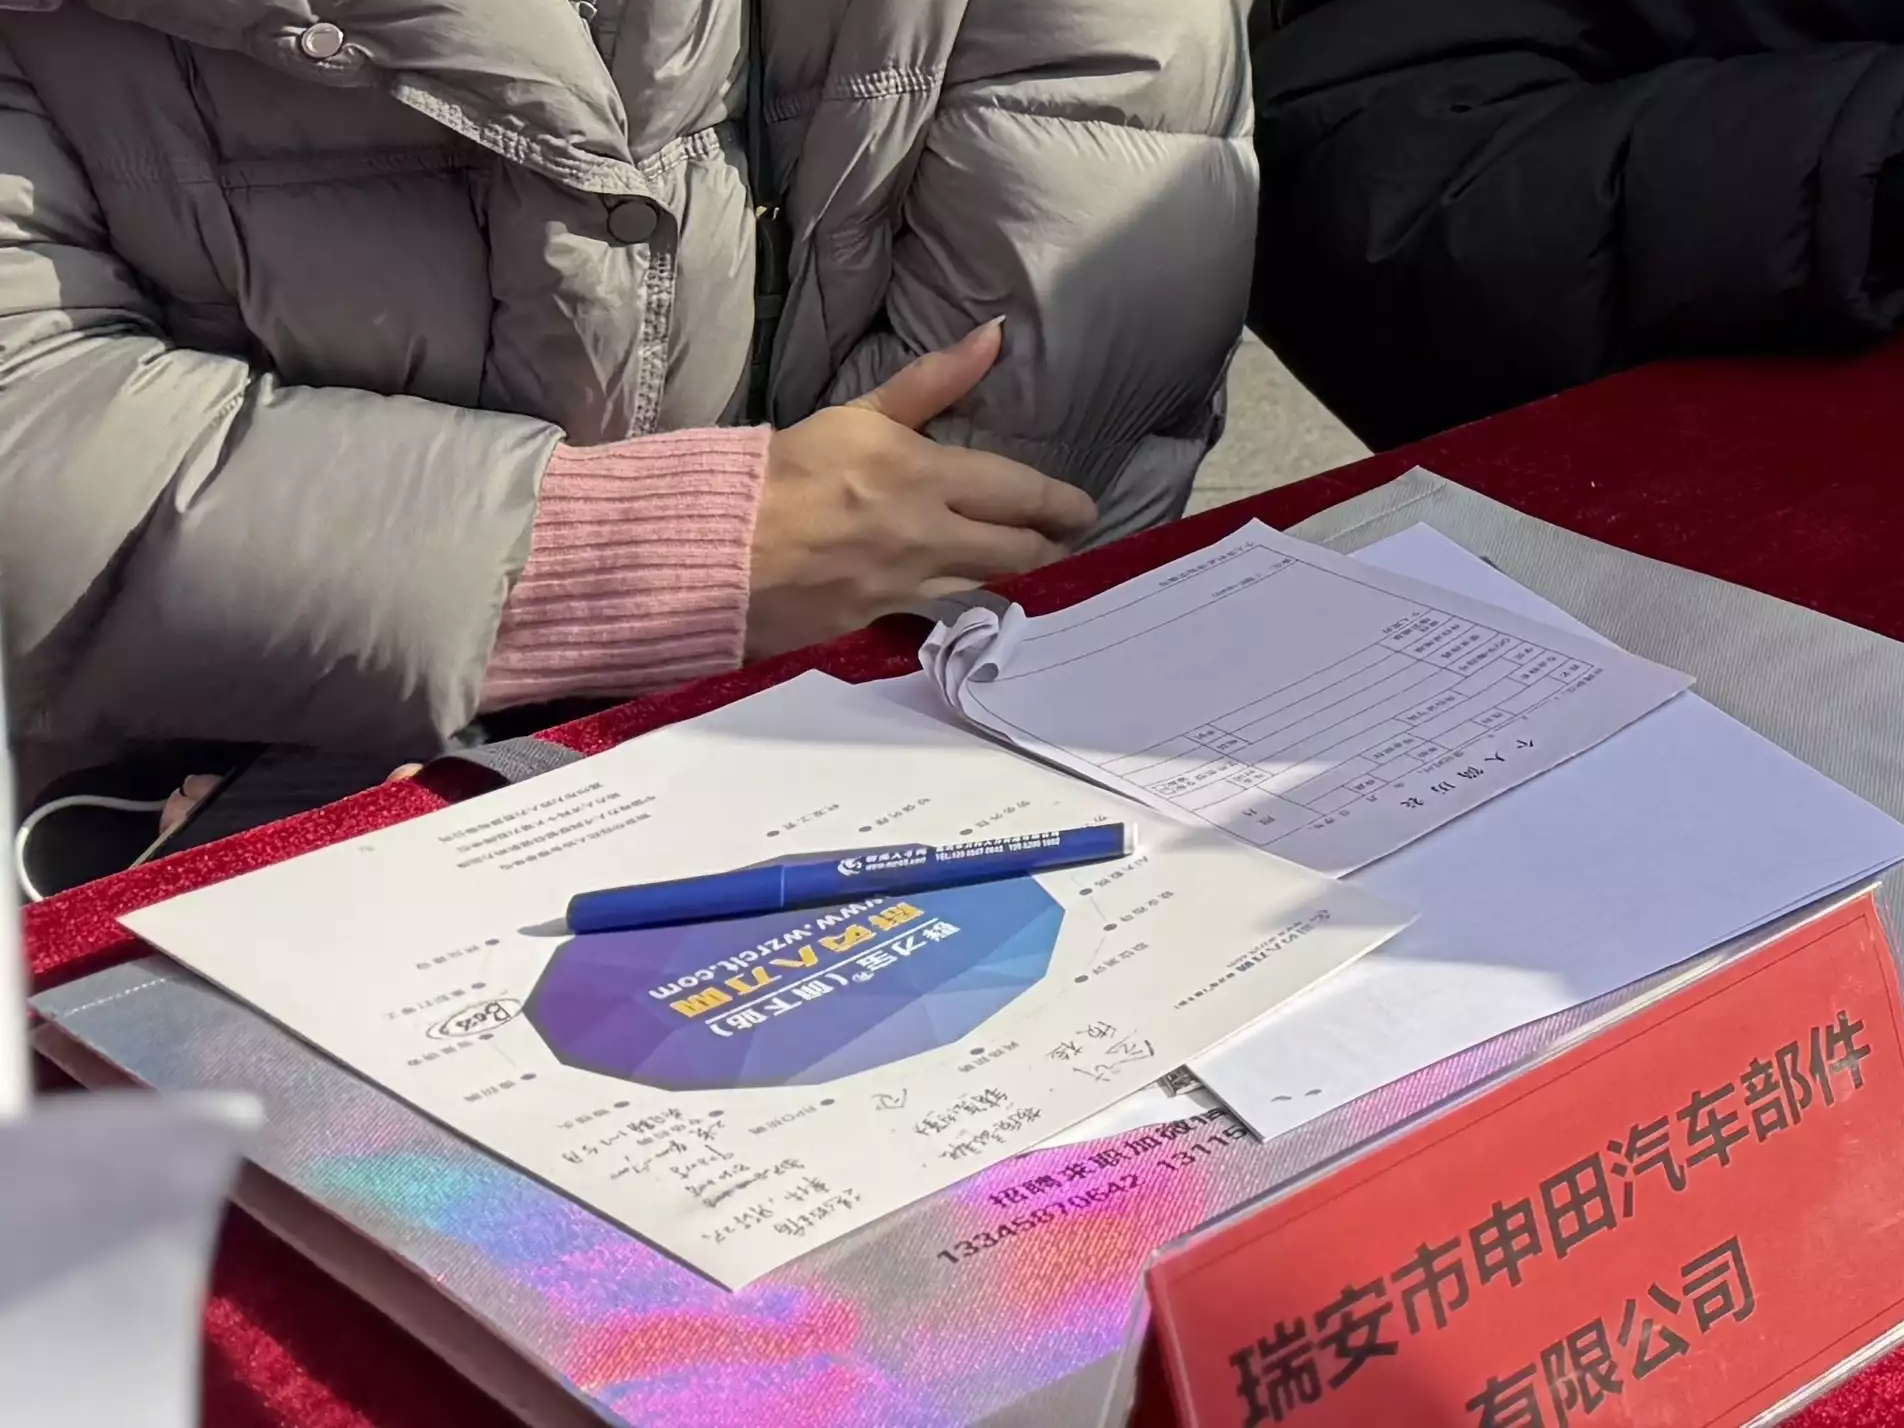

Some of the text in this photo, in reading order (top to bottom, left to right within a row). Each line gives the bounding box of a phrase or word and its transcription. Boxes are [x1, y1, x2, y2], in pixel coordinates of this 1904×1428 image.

[936, 1173, 1147, 1265] 13345870642
[1227, 1010, 1873, 1428] 瑞安市申田汽车部件
[1465, 1236, 1761, 1428] 有限公司
